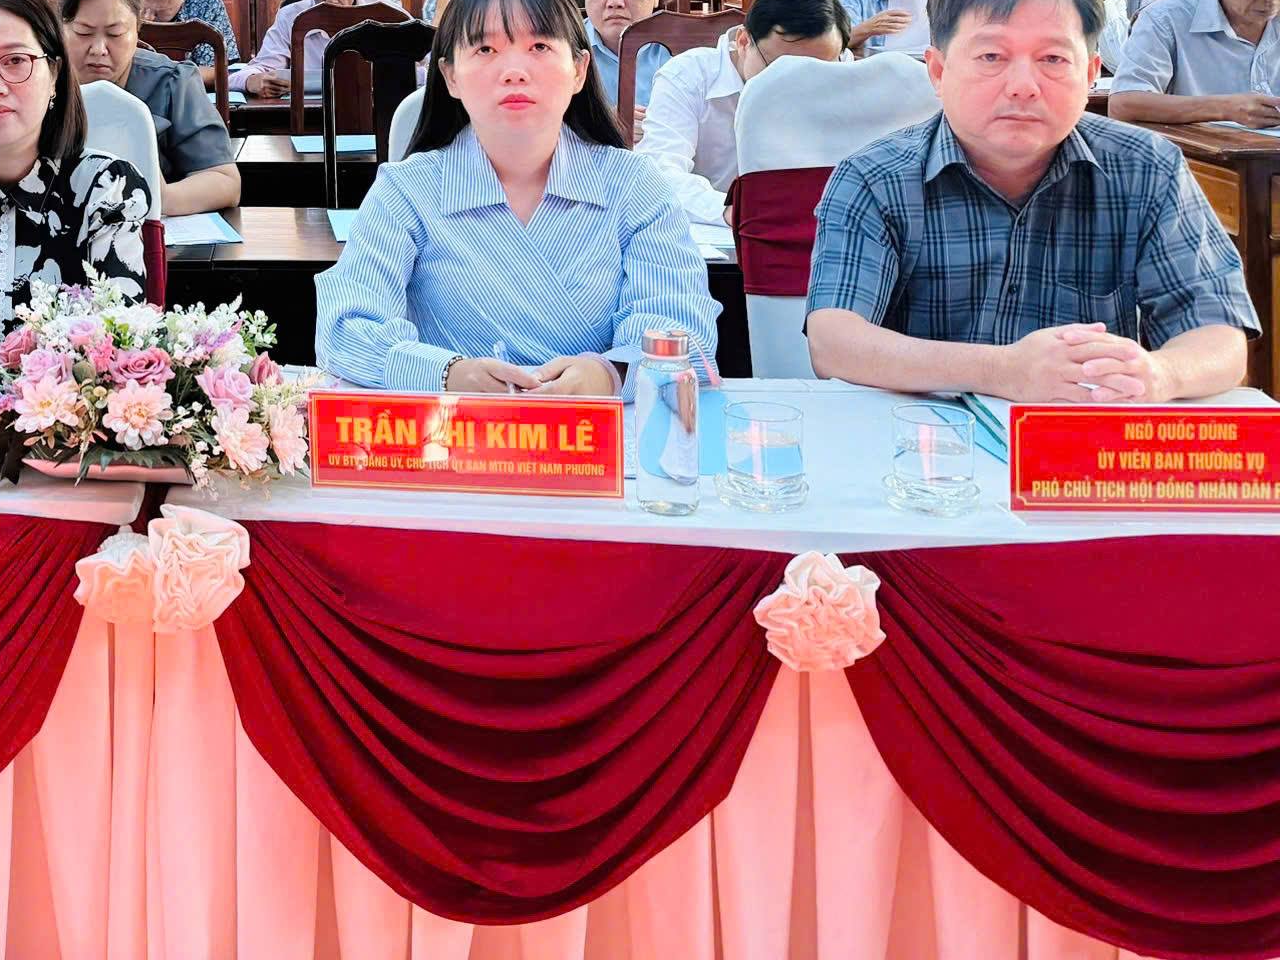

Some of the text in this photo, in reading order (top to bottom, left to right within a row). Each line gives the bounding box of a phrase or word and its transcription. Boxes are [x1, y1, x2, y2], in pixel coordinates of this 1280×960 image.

[336, 409, 417, 446] TRẦN
[486, 422, 547, 449] KIM
[559, 418, 595, 452] LÊ
[1125, 420, 1154, 440] NGÔ
[1158, 417, 1195, 441] QUỐC
[1119, 451, 1150, 470] VIÊN
[1155, 452, 1184, 470] BAN
[1188, 448, 1242, 471] THƯỜNG
[1246, 452, 1265, 474] VỤ
[1032, 478, 1059, 498] PHÓ
[1095, 480, 1126, 501] TỊCH
[1129, 478, 1152, 502] HỘI
[1157, 475, 1194, 499] ĐỒNG
[1198, 478, 1238, 499] NHÂN
[1241, 478, 1271, 499] DÂN
